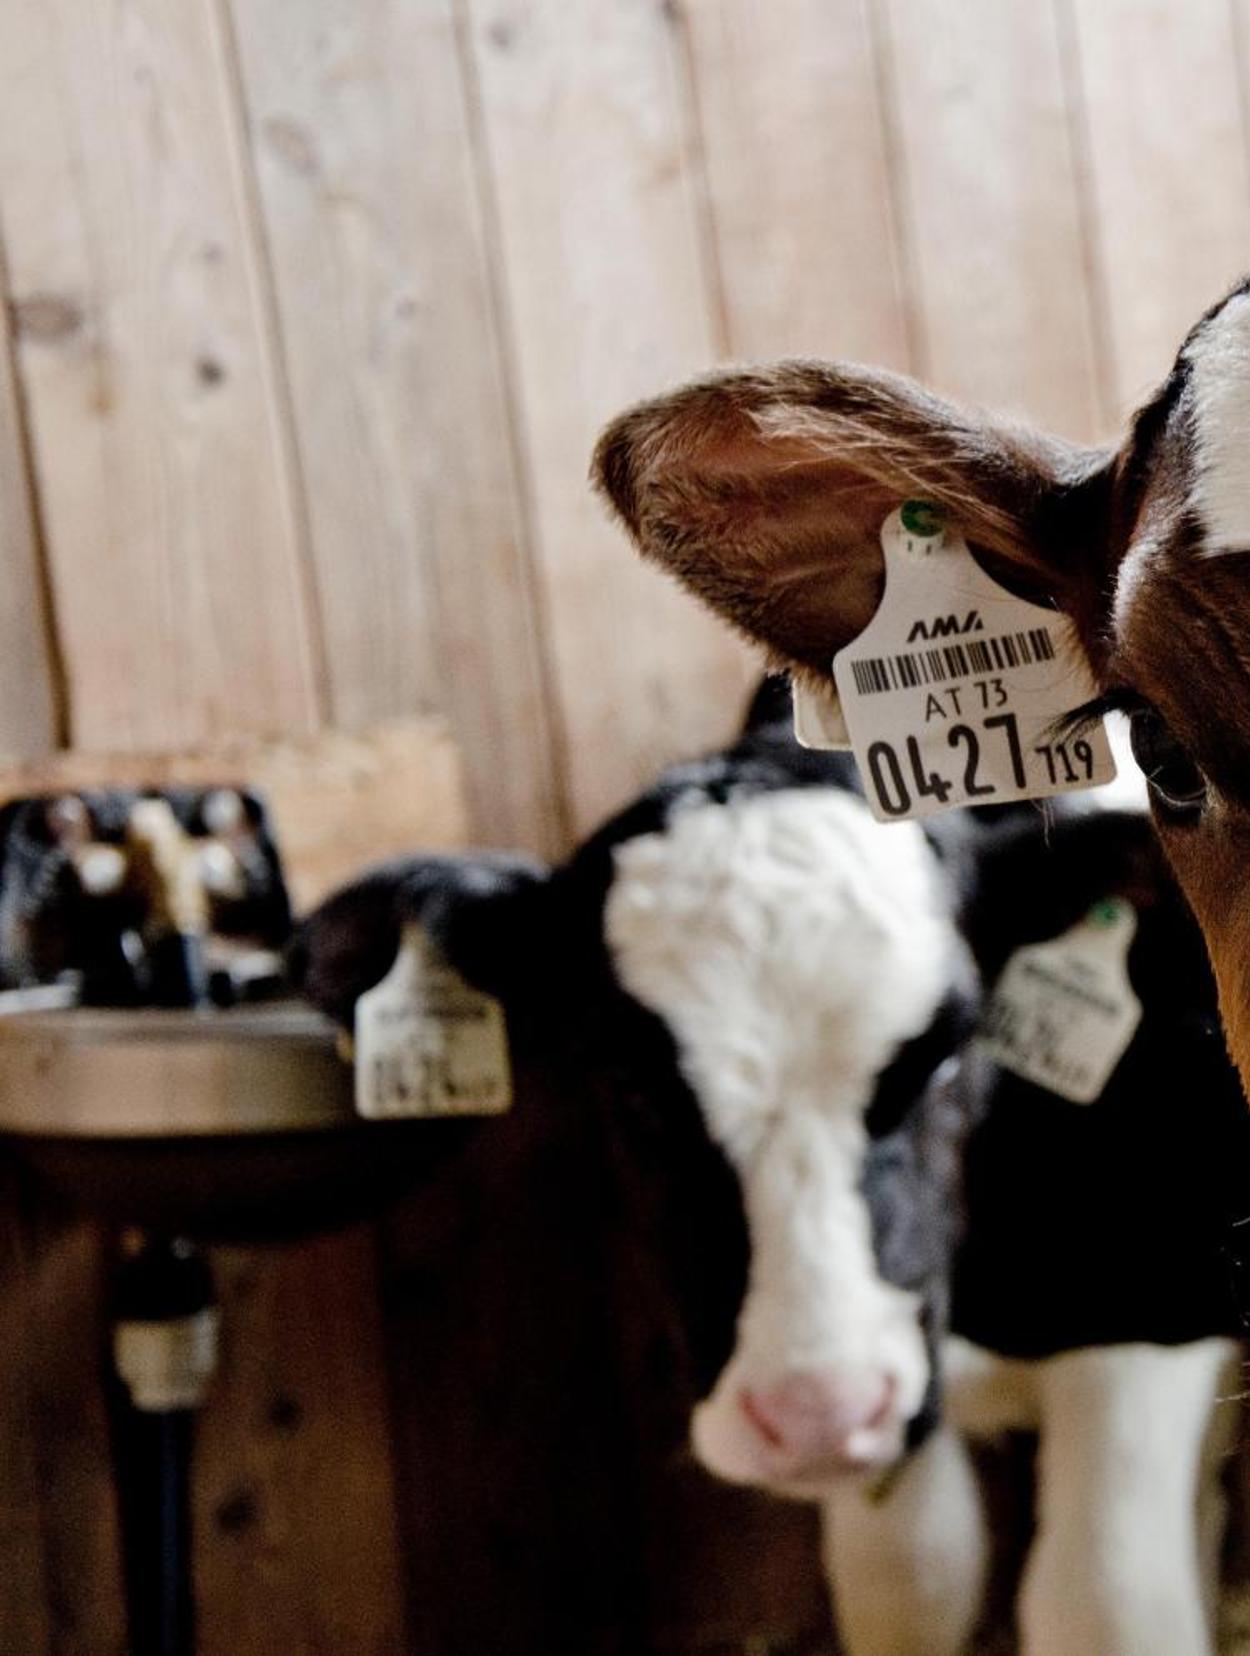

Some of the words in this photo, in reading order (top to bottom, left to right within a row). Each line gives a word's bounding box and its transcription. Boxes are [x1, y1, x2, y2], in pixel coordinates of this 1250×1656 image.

[924, 688, 962, 722] AT
[974, 679, 1008, 709] 73
[867, 713, 1027, 816] 0427
[1035, 740, 1093, 785] 719
